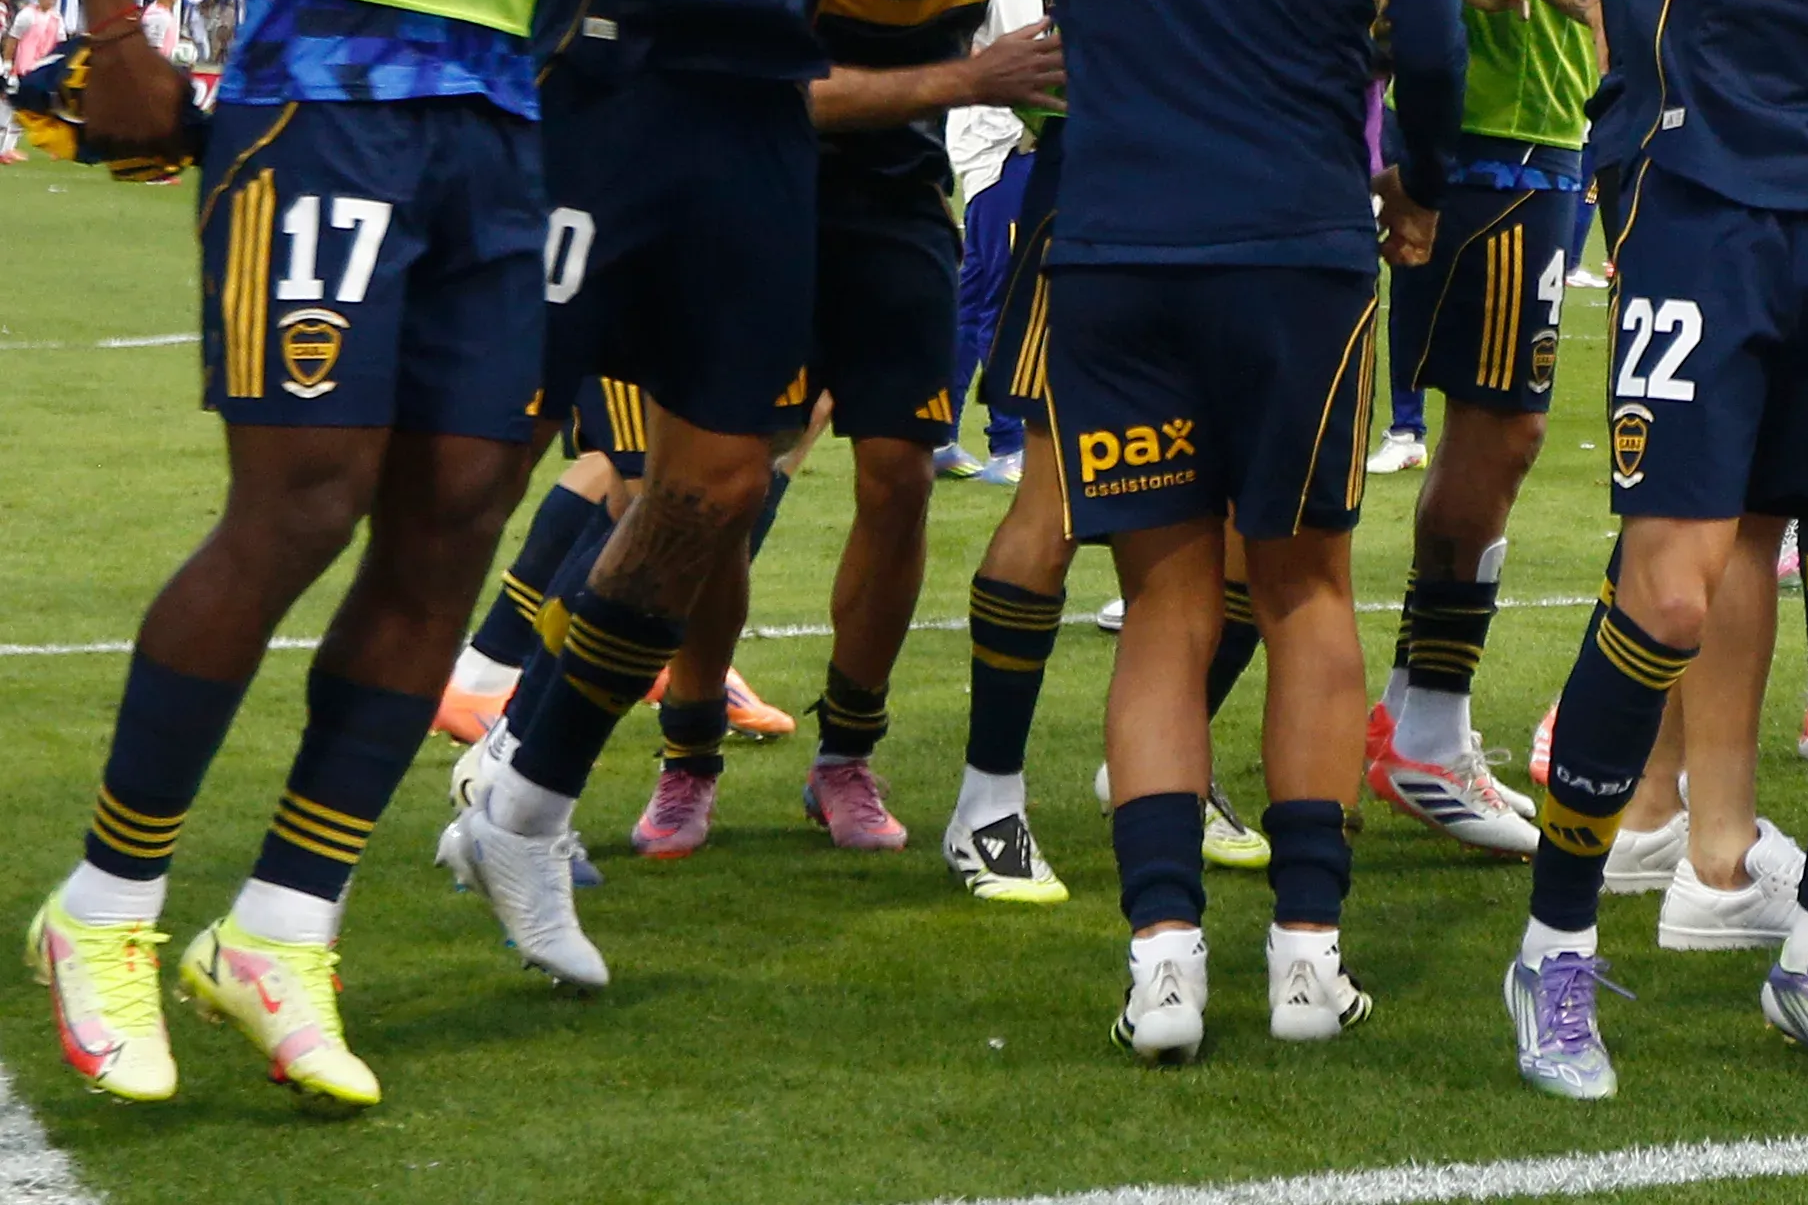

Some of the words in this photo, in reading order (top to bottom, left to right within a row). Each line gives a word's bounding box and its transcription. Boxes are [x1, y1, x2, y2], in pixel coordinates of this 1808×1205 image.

[277, 195, 394, 303] 17
[1616, 297, 1703, 402] 22
[1079, 418, 1196, 483] pax
[1084, 469, 1197, 499] assistance
